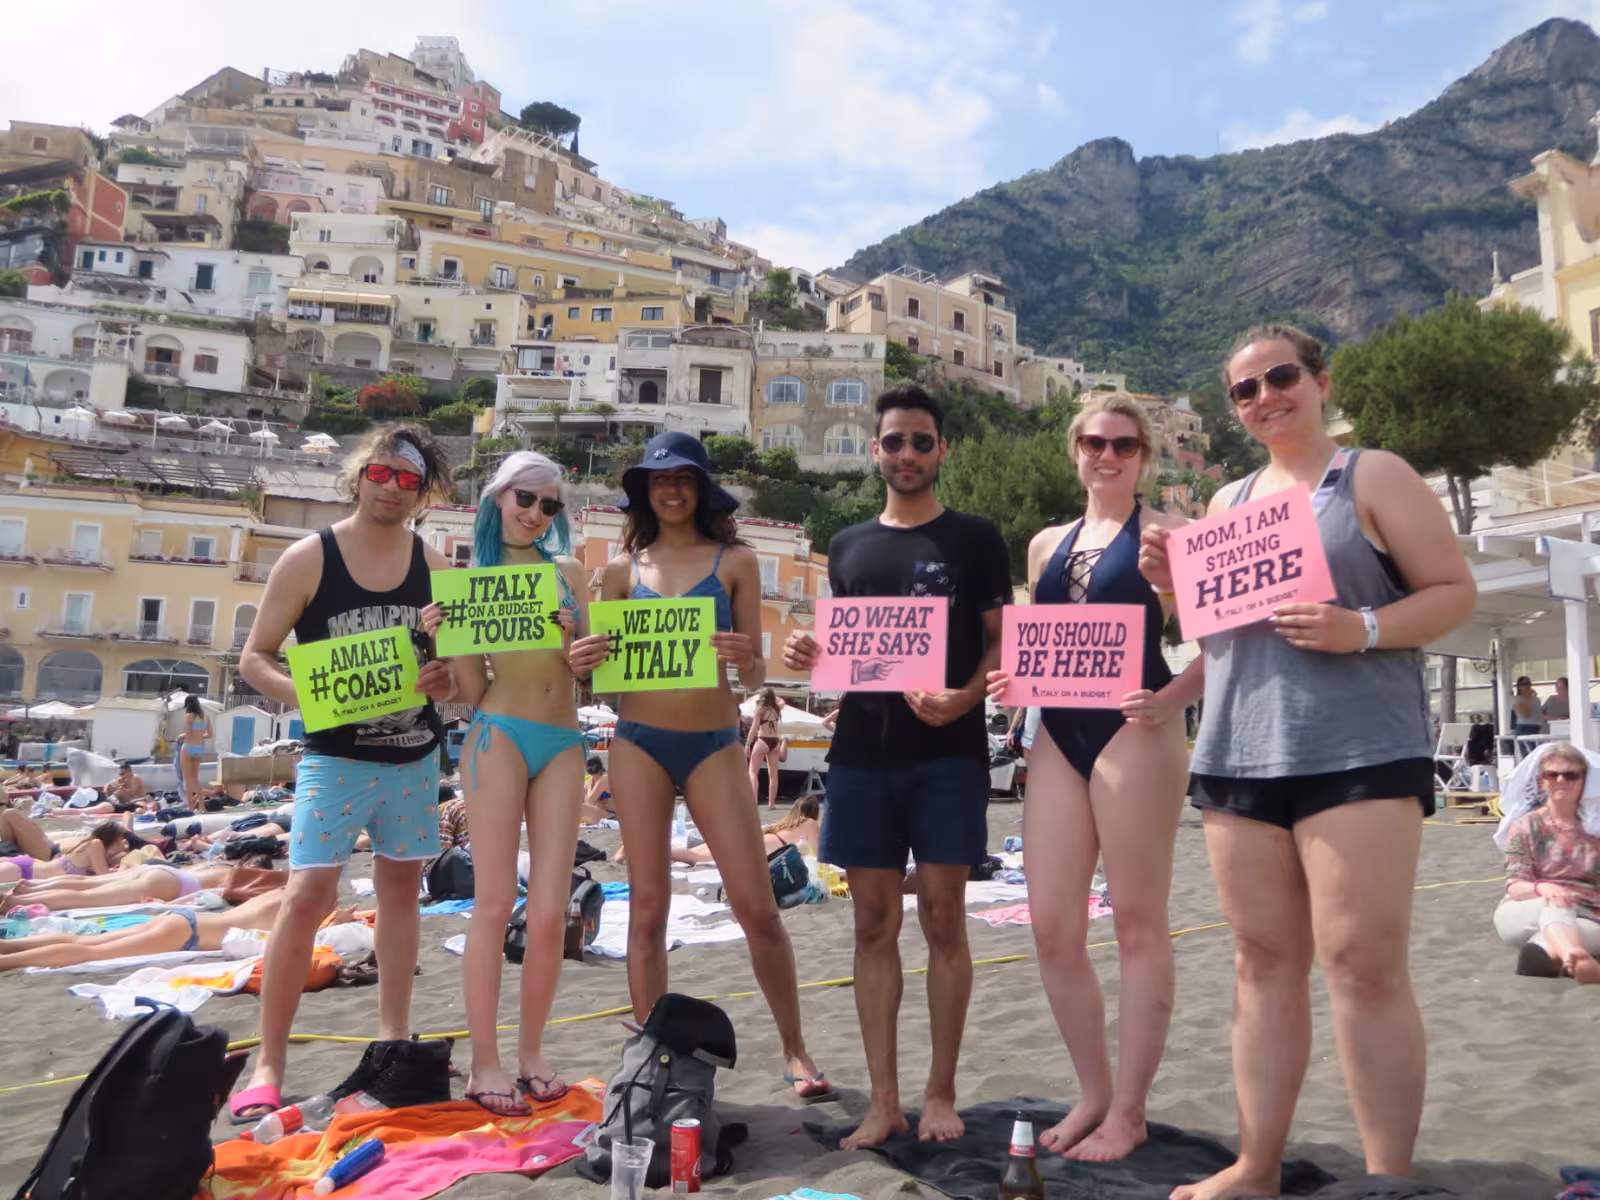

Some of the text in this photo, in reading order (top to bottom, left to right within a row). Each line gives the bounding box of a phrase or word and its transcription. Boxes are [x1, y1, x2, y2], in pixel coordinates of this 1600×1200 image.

[1187, 502, 1290, 555] MOM, I AM
[1206, 534, 1280, 572] STAYING
[468, 573, 542, 604] ITALY
[1196, 547, 1303, 609] HERE
[468, 601, 543, 618] ON A BUDGET
[623, 607, 701, 635] WE LOVE
[829, 606, 935, 629] DO WHAT
[470, 615, 546, 645] TOURS
[827, 632, 932, 656] SHE SAYS
[1017, 622, 1127, 647] YOU SHOULD
[330, 636, 399, 673] AMALFI
[1014, 650, 1125, 678] BE HERE
[1080, 690, 1111, 698] BUDGET
